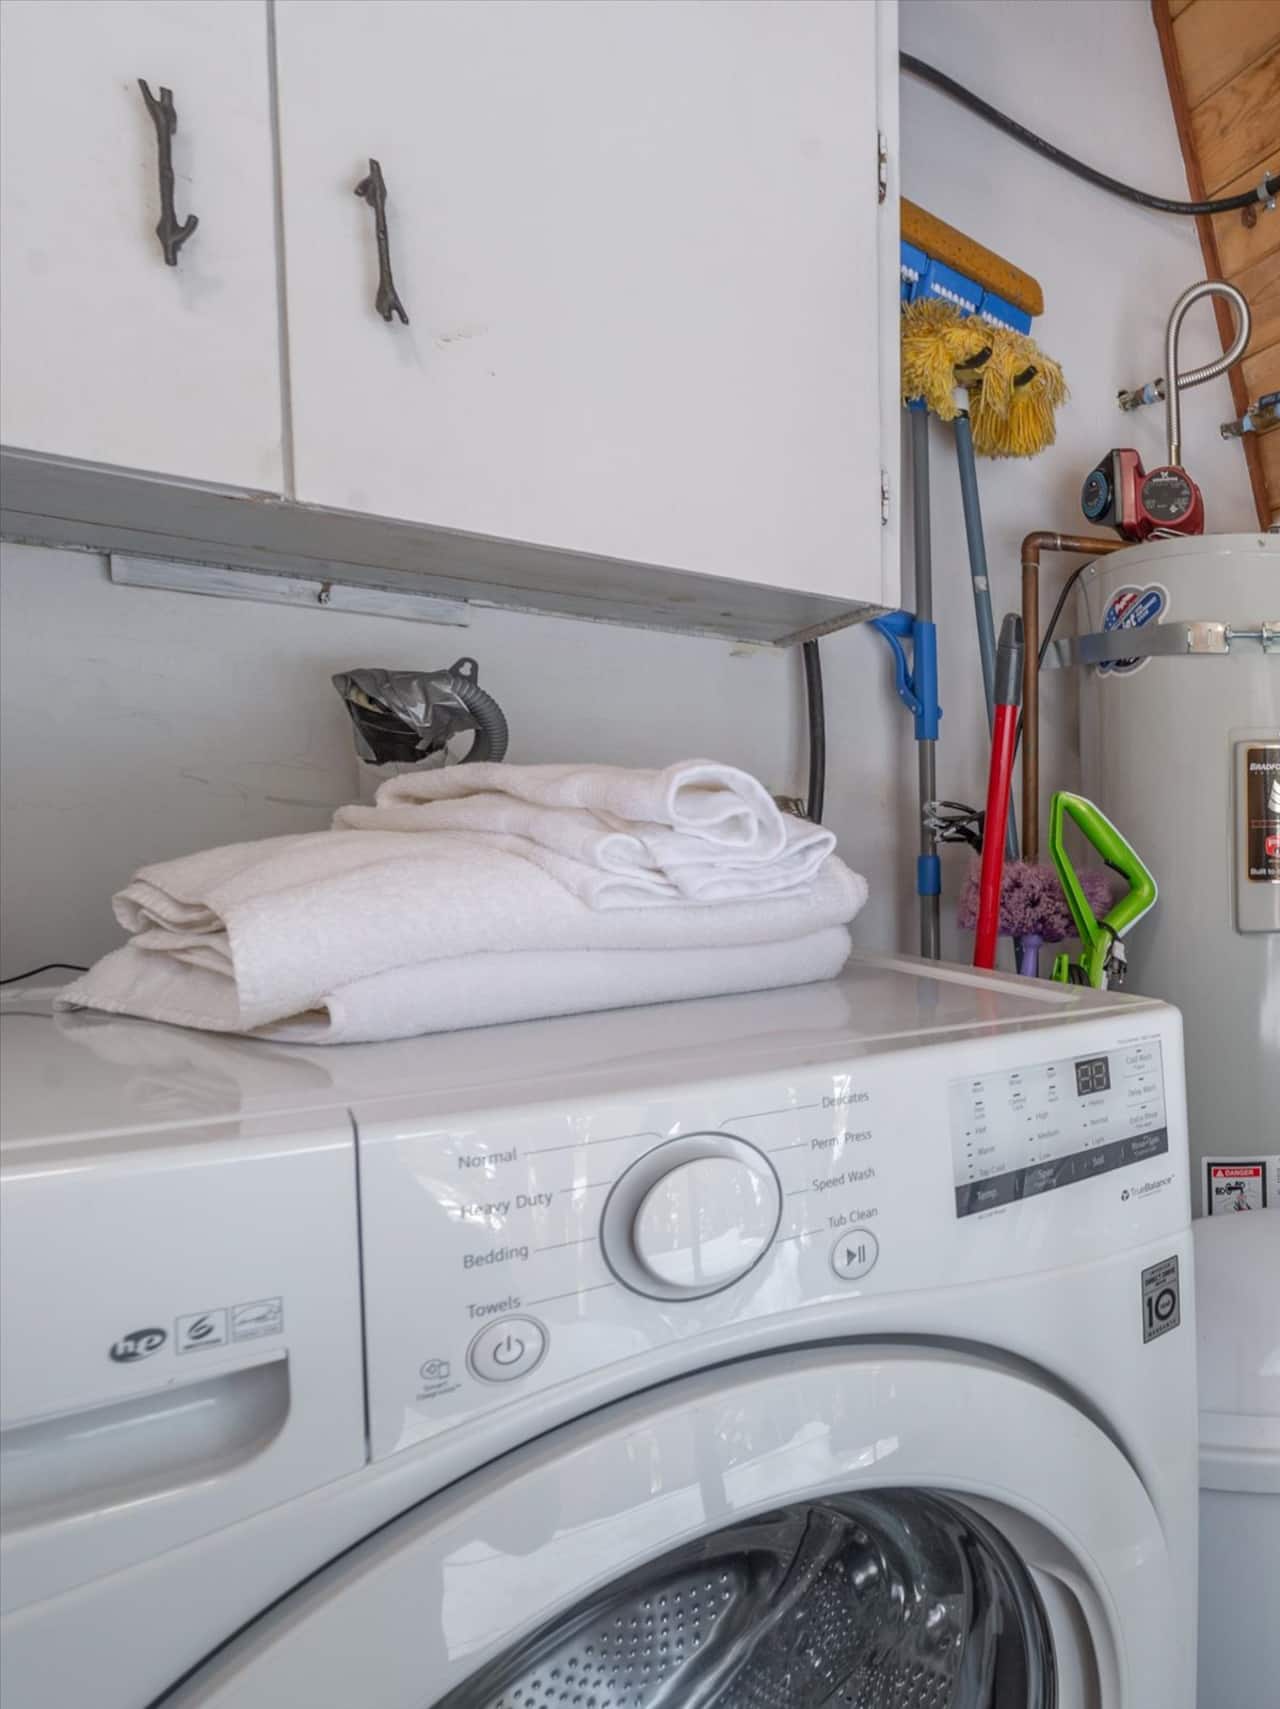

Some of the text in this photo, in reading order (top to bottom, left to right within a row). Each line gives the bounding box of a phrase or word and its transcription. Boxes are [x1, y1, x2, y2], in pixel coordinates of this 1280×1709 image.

[822, 1091, 870, 1108] Delicates
[844, 1130, 872, 1144] Press
[457, 1146, 518, 1169] Normal
[812, 1167, 876, 1192] Speed Wash
[1224, 1169, 1254, 1178] DANGER
[460, 1191, 553, 1219] Heavy Duty
[827, 1207, 879, 1228] Tub Clean
[463, 1246, 530, 1270] Bedding
[466, 1296, 522, 1319] Towels
[1146, 1288, 1177, 1328] 10
